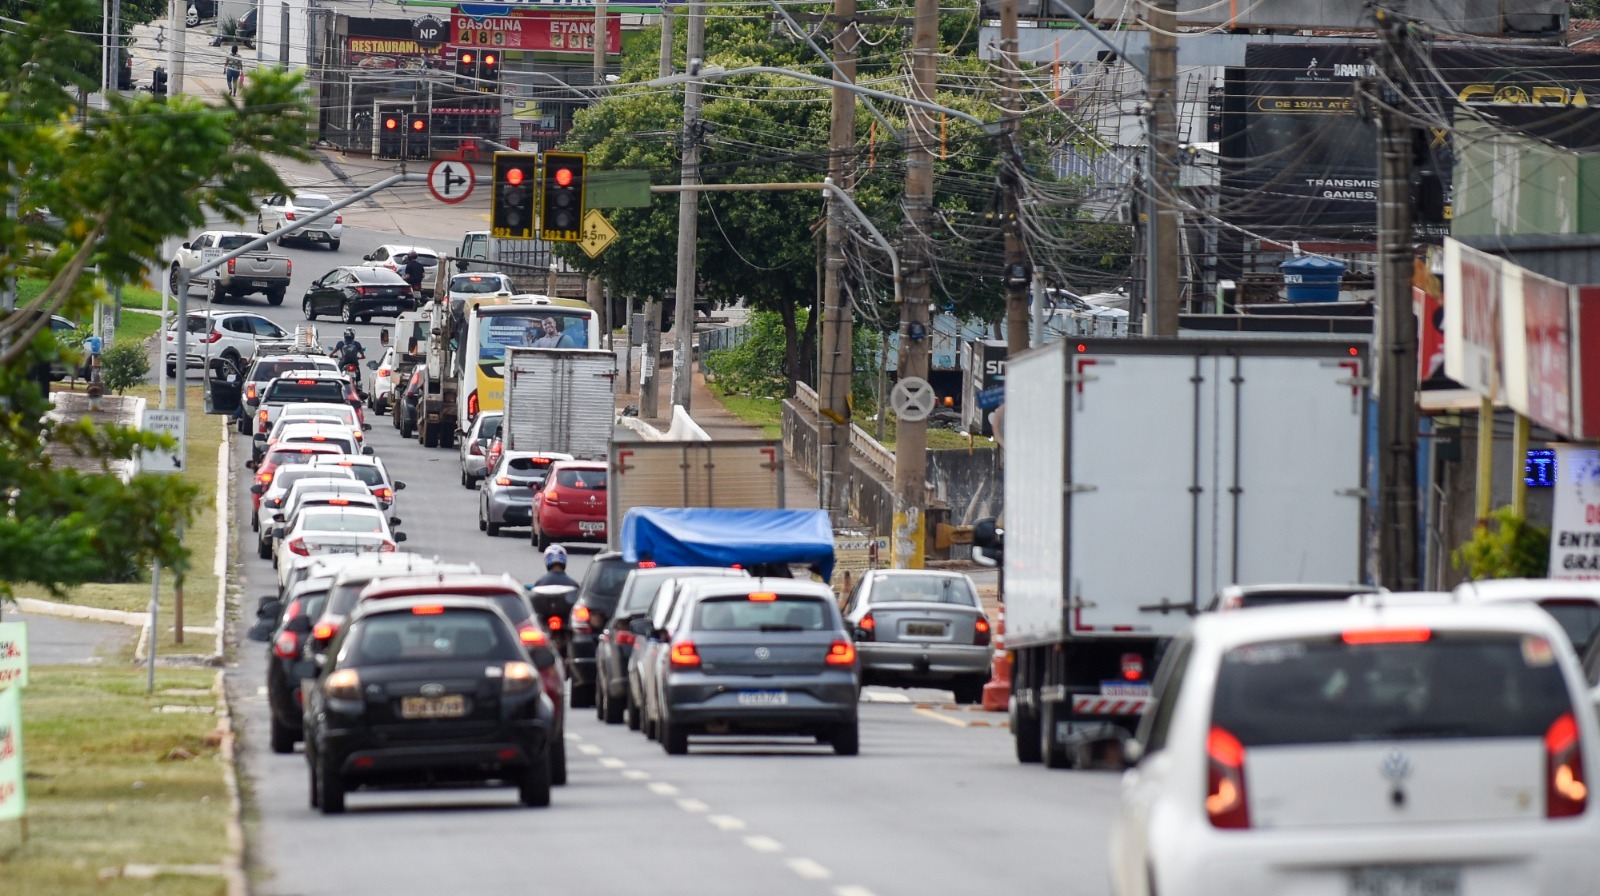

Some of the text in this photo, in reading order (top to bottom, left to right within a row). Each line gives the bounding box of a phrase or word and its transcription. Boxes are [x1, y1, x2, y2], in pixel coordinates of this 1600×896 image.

[458, 18, 522, 31] GASOLINA
[551, 22, 610, 34] ETANO
[420, 29, 438, 39] NP
[1323, 190, 1377, 200] GAMES,
